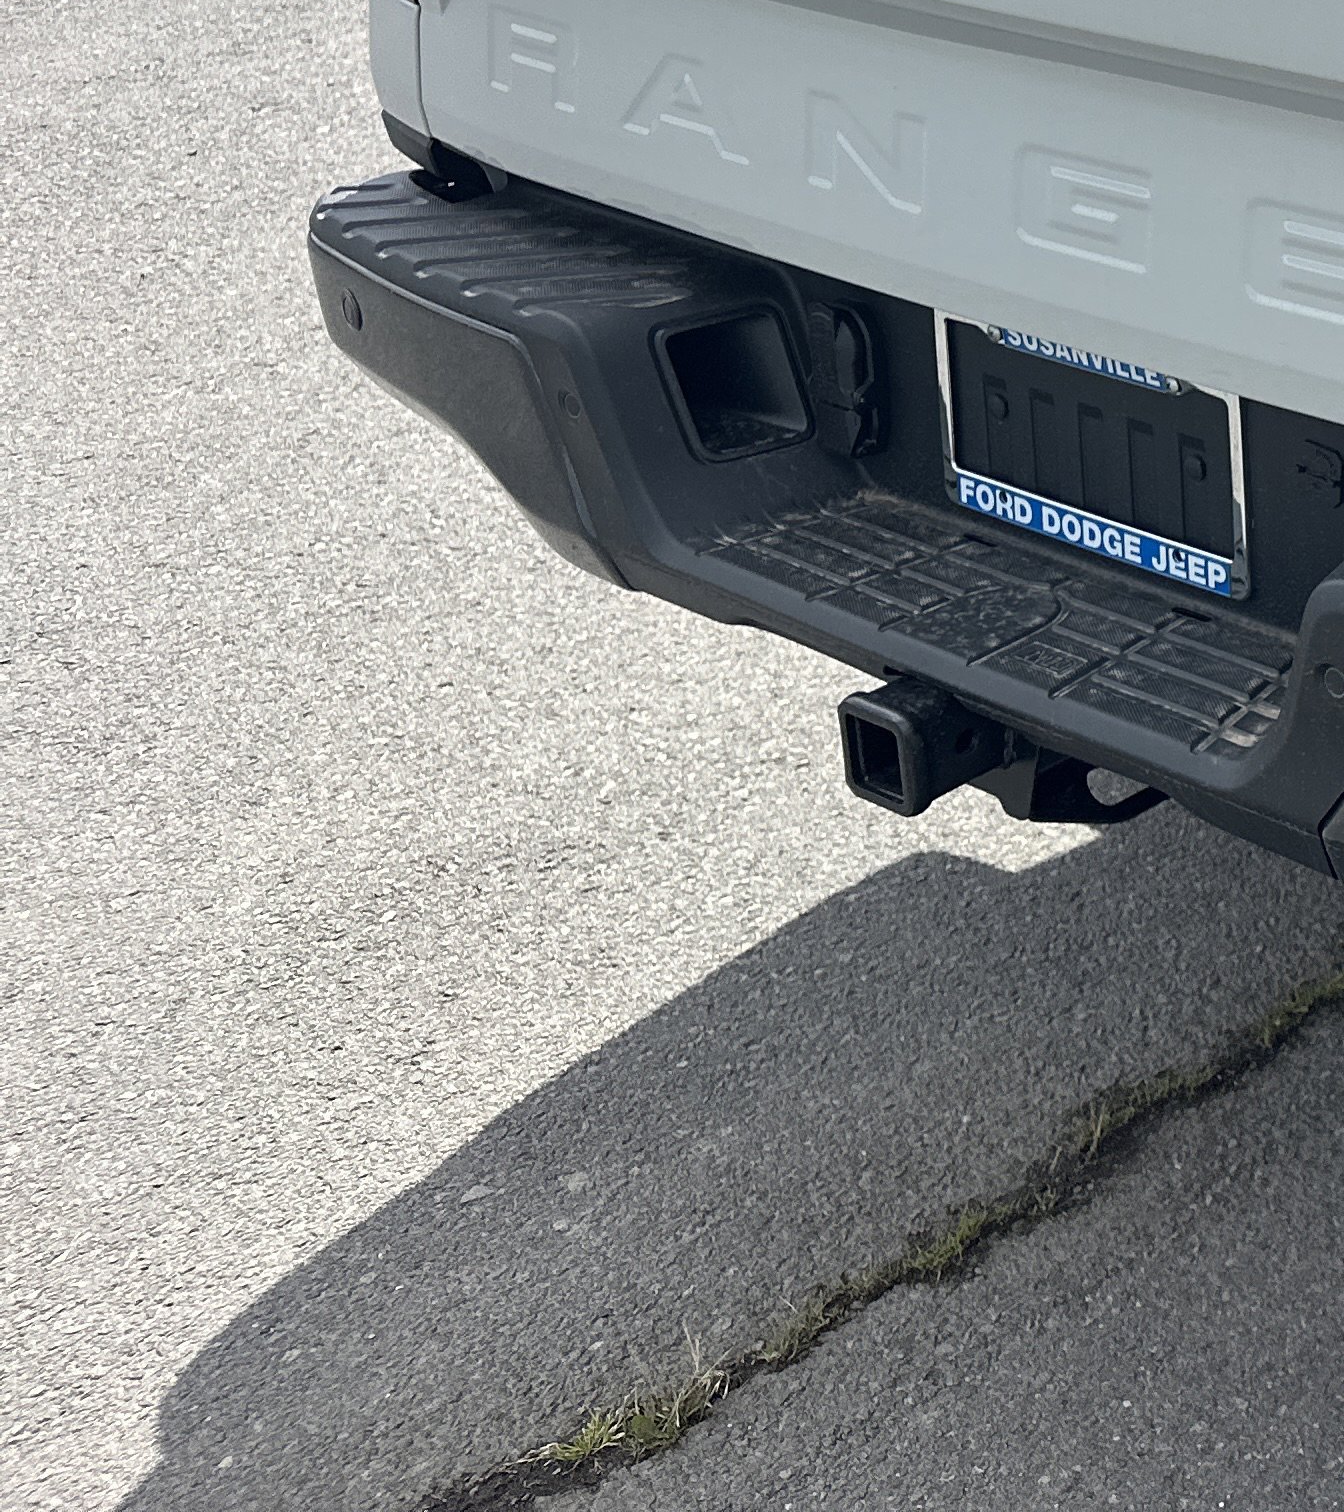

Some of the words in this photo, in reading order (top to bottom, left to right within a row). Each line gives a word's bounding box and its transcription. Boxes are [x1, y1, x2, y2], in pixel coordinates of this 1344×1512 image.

[959, 478, 1033, 525] FORD
[1042, 508, 1142, 563] DODGE
[1152, 546, 1227, 588] JEEP
